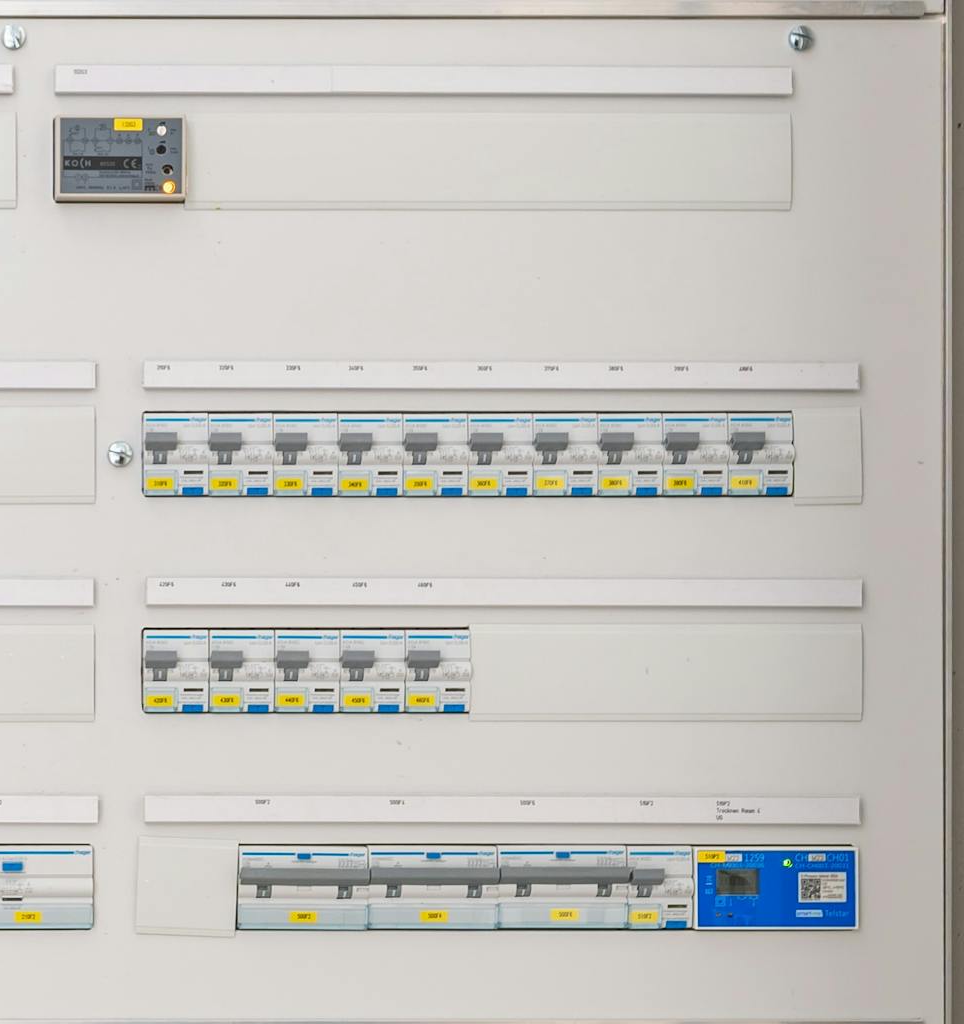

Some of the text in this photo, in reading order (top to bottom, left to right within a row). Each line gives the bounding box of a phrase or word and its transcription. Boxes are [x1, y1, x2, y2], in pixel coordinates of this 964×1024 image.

[745, 853, 765, 862] 1259
[795, 853, 849, 862] CH CH01
